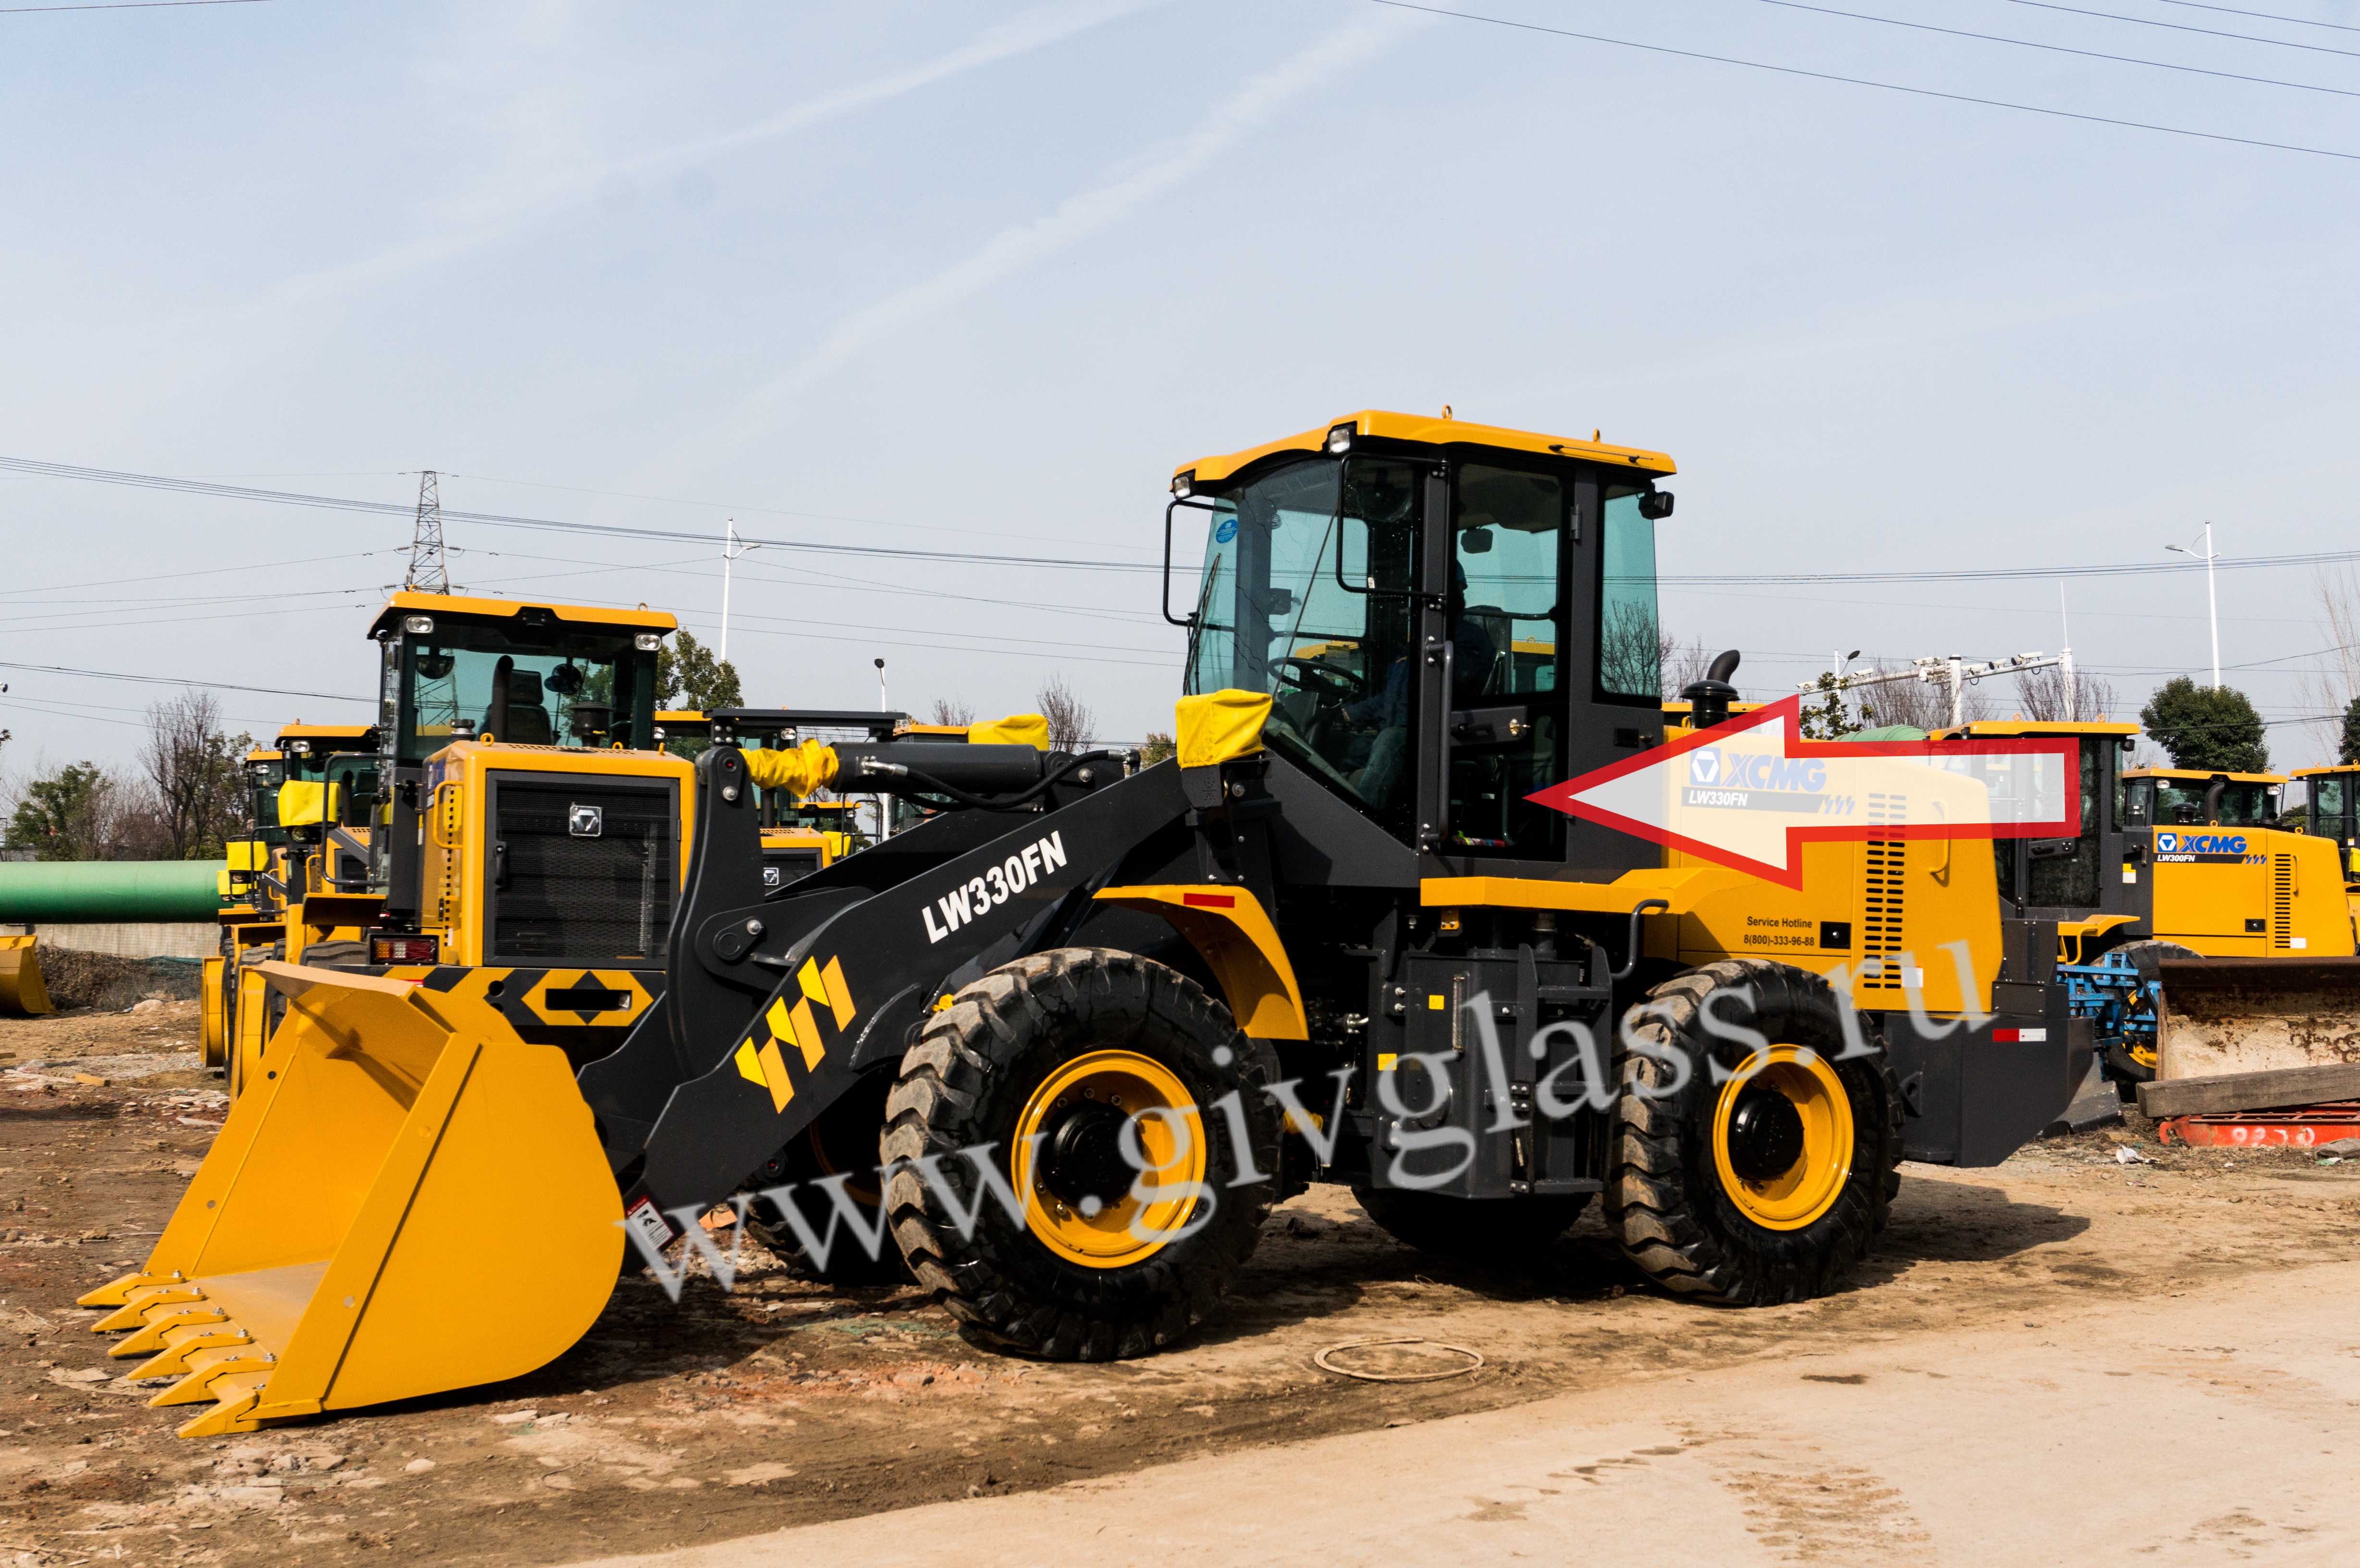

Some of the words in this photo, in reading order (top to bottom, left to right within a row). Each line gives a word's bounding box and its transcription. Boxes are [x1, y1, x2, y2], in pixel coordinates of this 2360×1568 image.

[1721, 753, 1827, 793] XCMG
[1689, 790, 1748, 806] LW330FN
[2177, 835, 2247, 854] XCMG
[922, 830, 1067, 944] LW330FN
[1747, 916, 1779, 927] Service
[1782, 918, 1812, 928] Hotline
[1744, 934, 1814, 947] 8(800)-333-96-88
